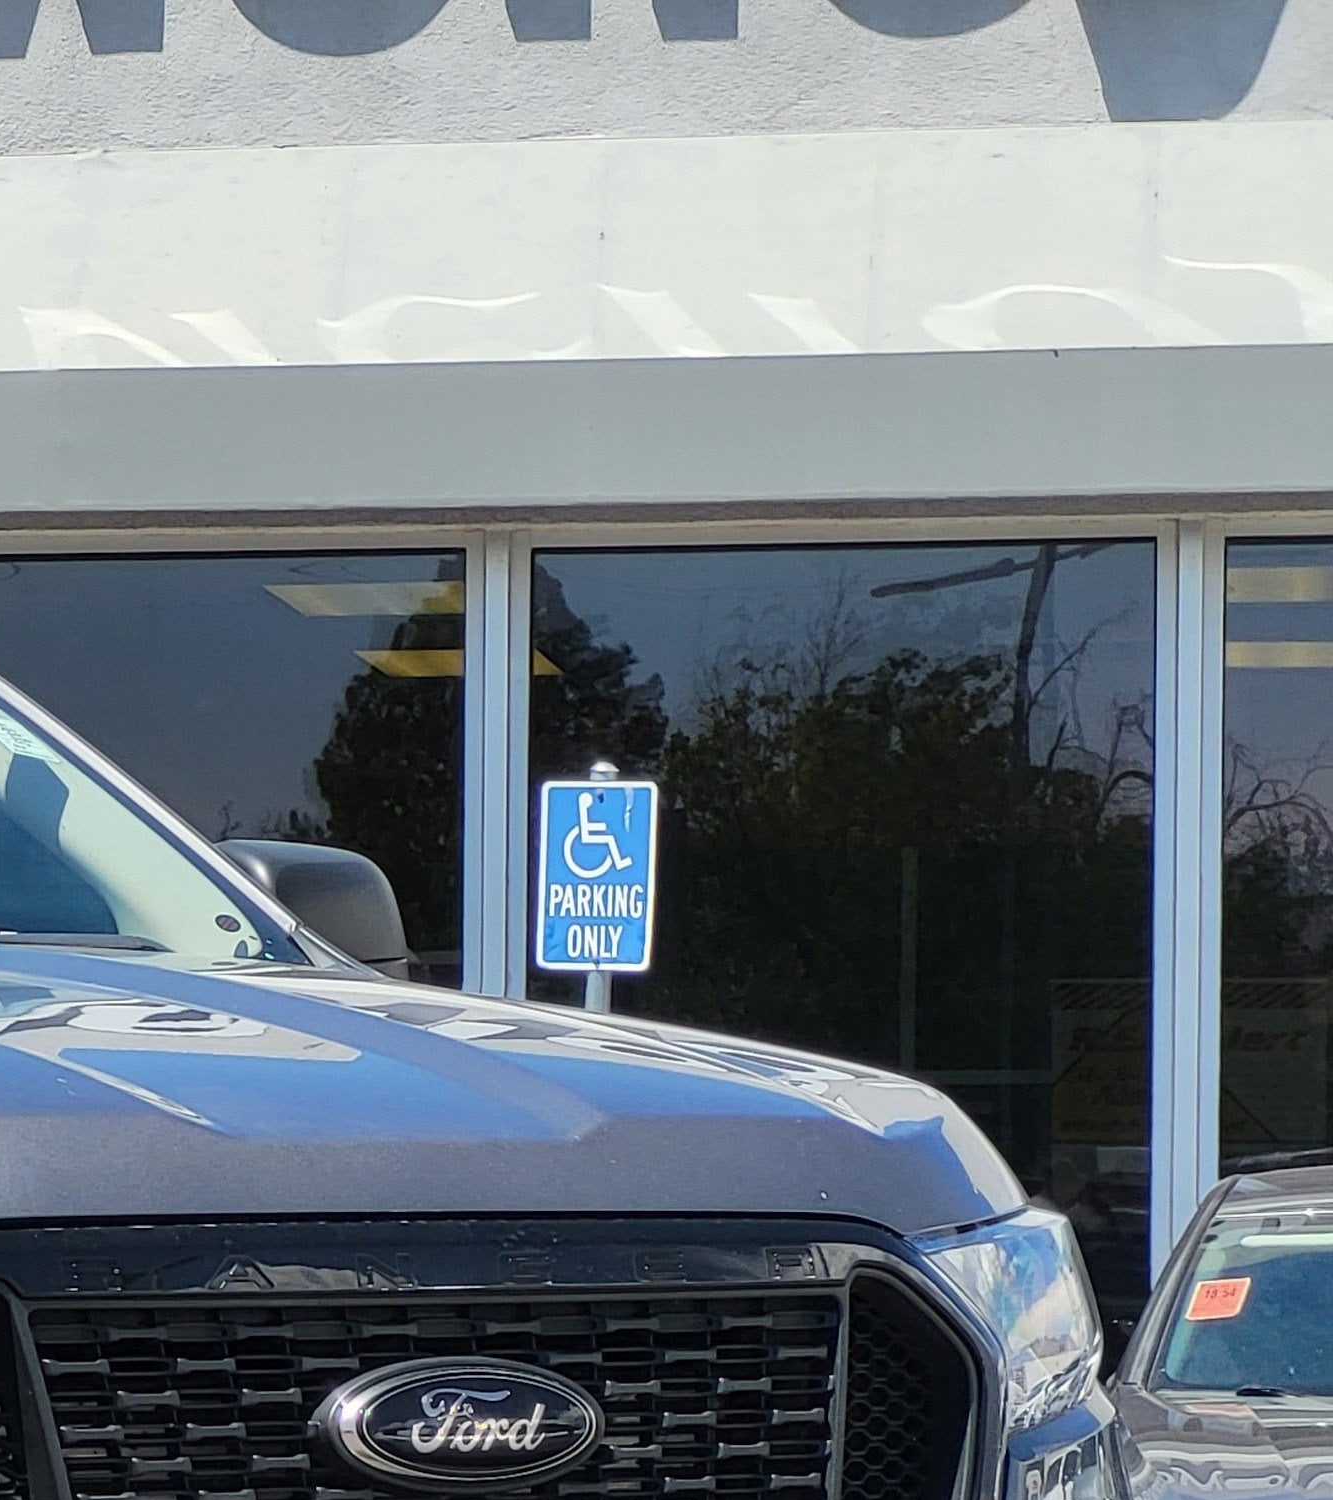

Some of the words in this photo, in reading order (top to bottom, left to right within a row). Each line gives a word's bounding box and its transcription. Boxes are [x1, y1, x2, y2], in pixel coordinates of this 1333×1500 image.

[549, 884, 645, 919] PARKING
[567, 924, 624, 959] ONLY
[411, 1387, 546, 1454] Ford
